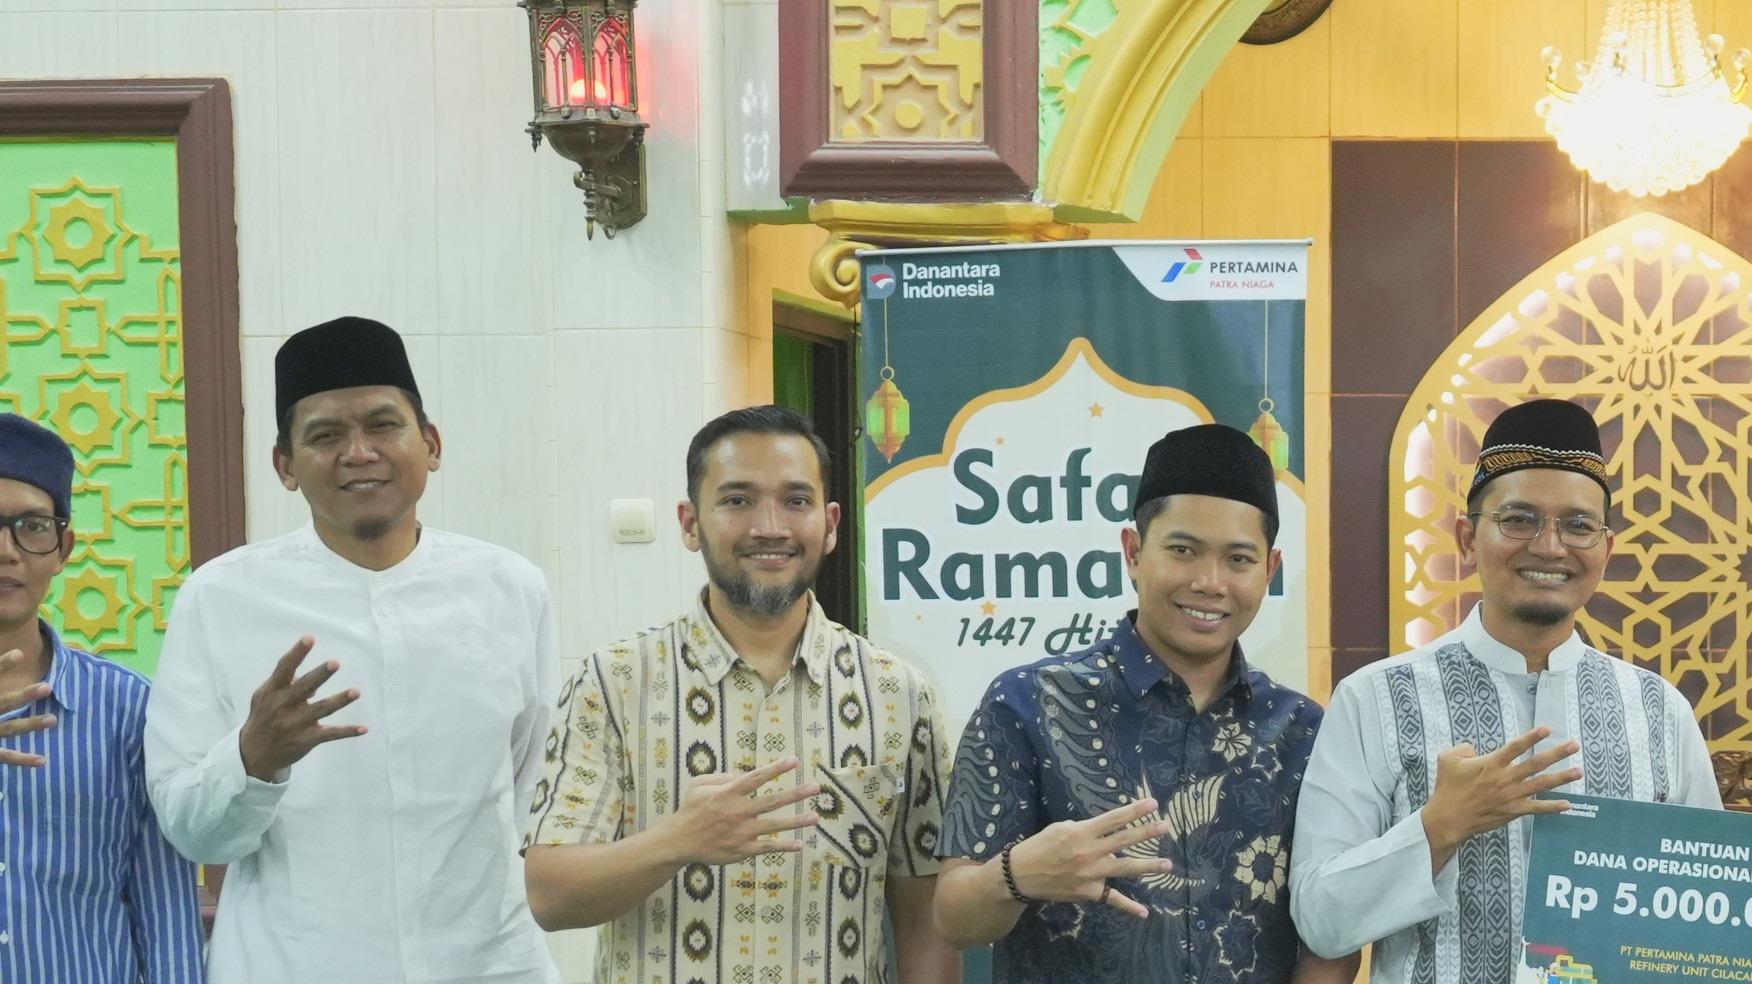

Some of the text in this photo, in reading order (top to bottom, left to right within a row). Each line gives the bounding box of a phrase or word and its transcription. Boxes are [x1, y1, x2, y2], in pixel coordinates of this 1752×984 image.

[902, 262, 1001, 280] Danantara
[1210, 261, 1298, 273] PERTAMINA
[903, 279, 995, 299] Indonesia
[1210, 280, 1275, 289] PATRA NIAGA
[953, 447, 1142, 526] Safa
[958, 616, 1036, 648] 1447
[1573, 850, 1628, 870] DANA
[1660, 838, 1750, 862] BANTUAN
[1545, 874, 1599, 919] Rp
[1619, 945, 1633, 956] PT
[1635, 946, 1695, 962] PERTAMINA
[1697, 953, 1730, 966] PATRA
[1629, 959, 1680, 974] REFINERY
[1681, 965, 1710, 977] UNIT
